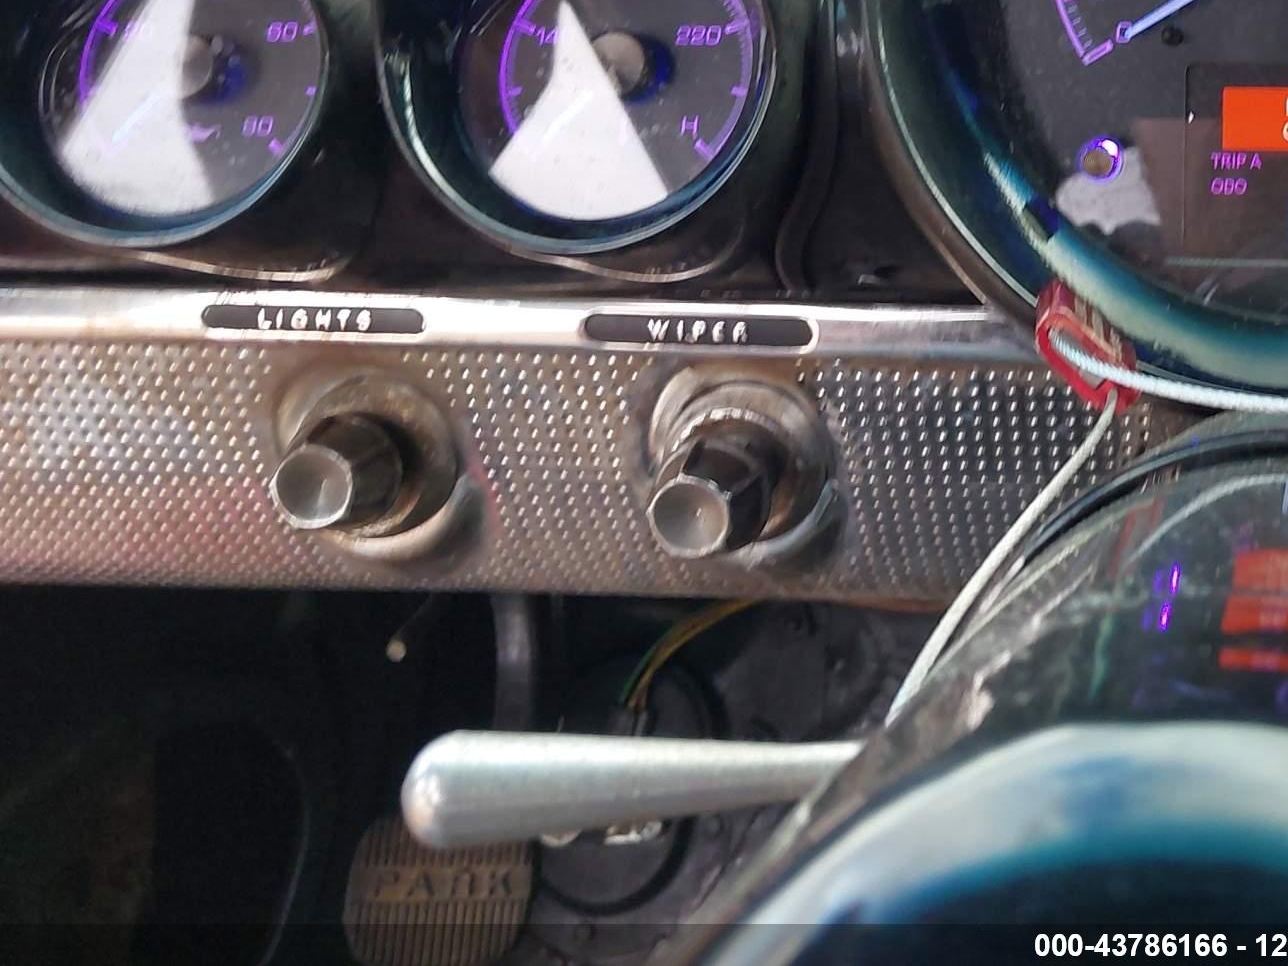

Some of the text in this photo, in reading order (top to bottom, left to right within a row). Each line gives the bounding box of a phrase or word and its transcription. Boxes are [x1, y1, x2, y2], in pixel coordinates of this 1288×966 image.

[267, 21, 298, 43] 60
[675, 25, 722, 46] 220
[680, 115, 699, 136] H
[1211, 153, 1247, 170] TRIP
[1250, 153, 1262, 170] A
[257, 307, 371, 332] LIGHTS
[647, 318, 749, 344] WIPER
